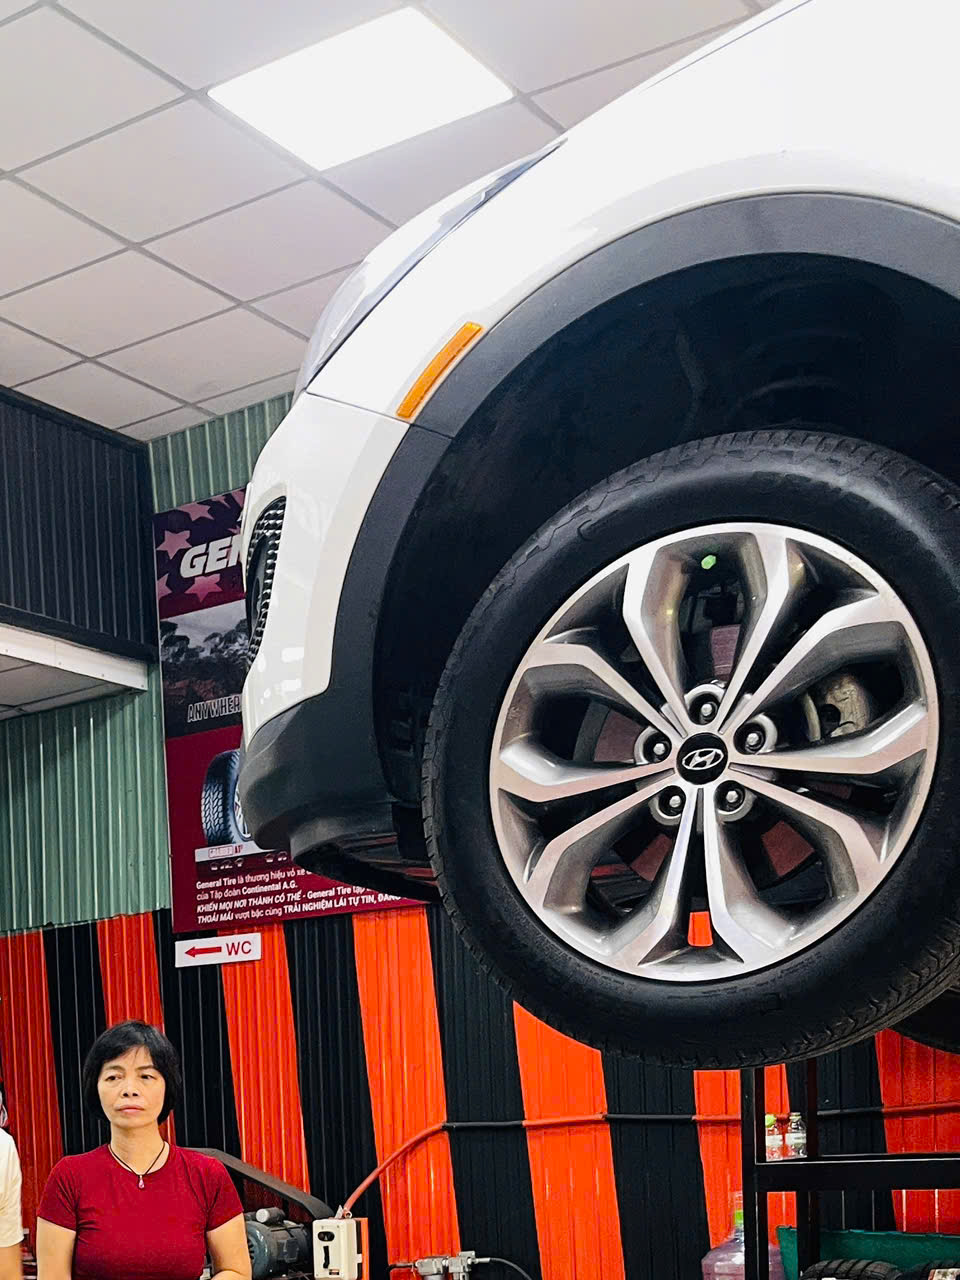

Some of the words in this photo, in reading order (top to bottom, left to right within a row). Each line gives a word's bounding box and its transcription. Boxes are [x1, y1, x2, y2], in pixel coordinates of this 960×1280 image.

[196, 878, 222, 890] General
[223, 877, 236, 887] Tire
[241, 883, 281, 895] Continental
[282, 880, 298, 890] A.G.
[307, 887, 335, 899] General
[337, 886, 351, 896] Tire
[302, 899, 333, 912] NGHIỆM
[361, 894, 377, 905] TIN,
[225, 940, 252, 956] WC
